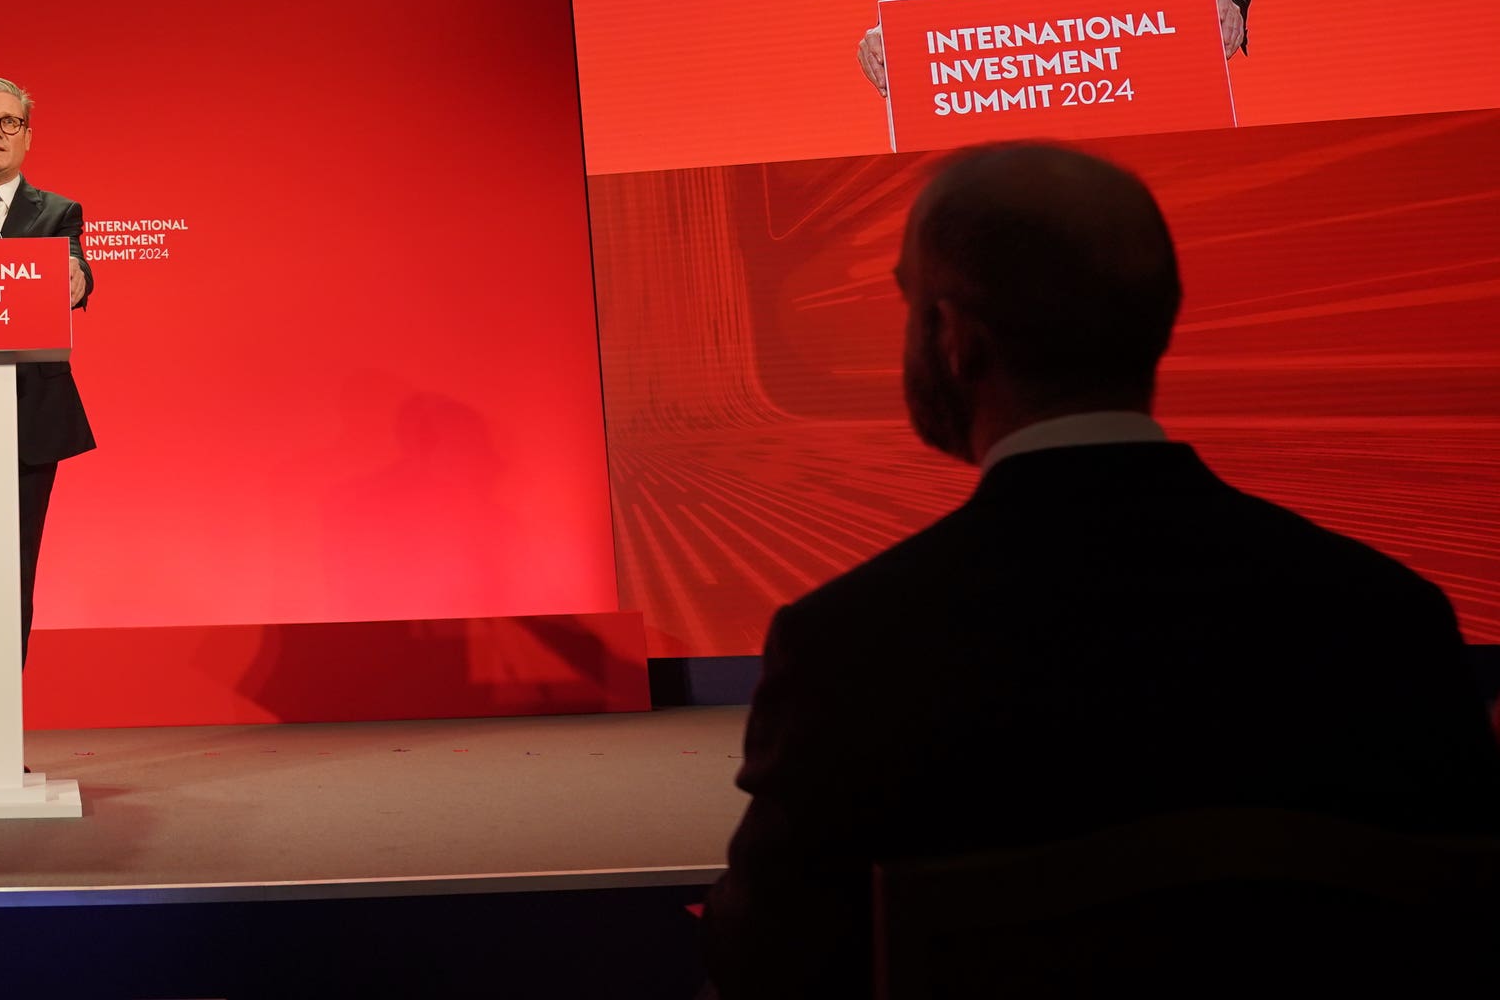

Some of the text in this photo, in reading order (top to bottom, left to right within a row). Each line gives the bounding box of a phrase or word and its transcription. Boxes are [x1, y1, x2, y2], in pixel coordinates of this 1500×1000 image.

[926, 11, 1176, 55] INTERNATIONAL
[930, 46, 1122, 86] INVESTMENT
[934, 78, 1136, 117] SUMMIT 2024
[85, 218, 188, 232] INTERNATIONAL
[85, 233, 165, 246] INVESTMENT
[85, 247, 170, 261] SUMMIT 2024
